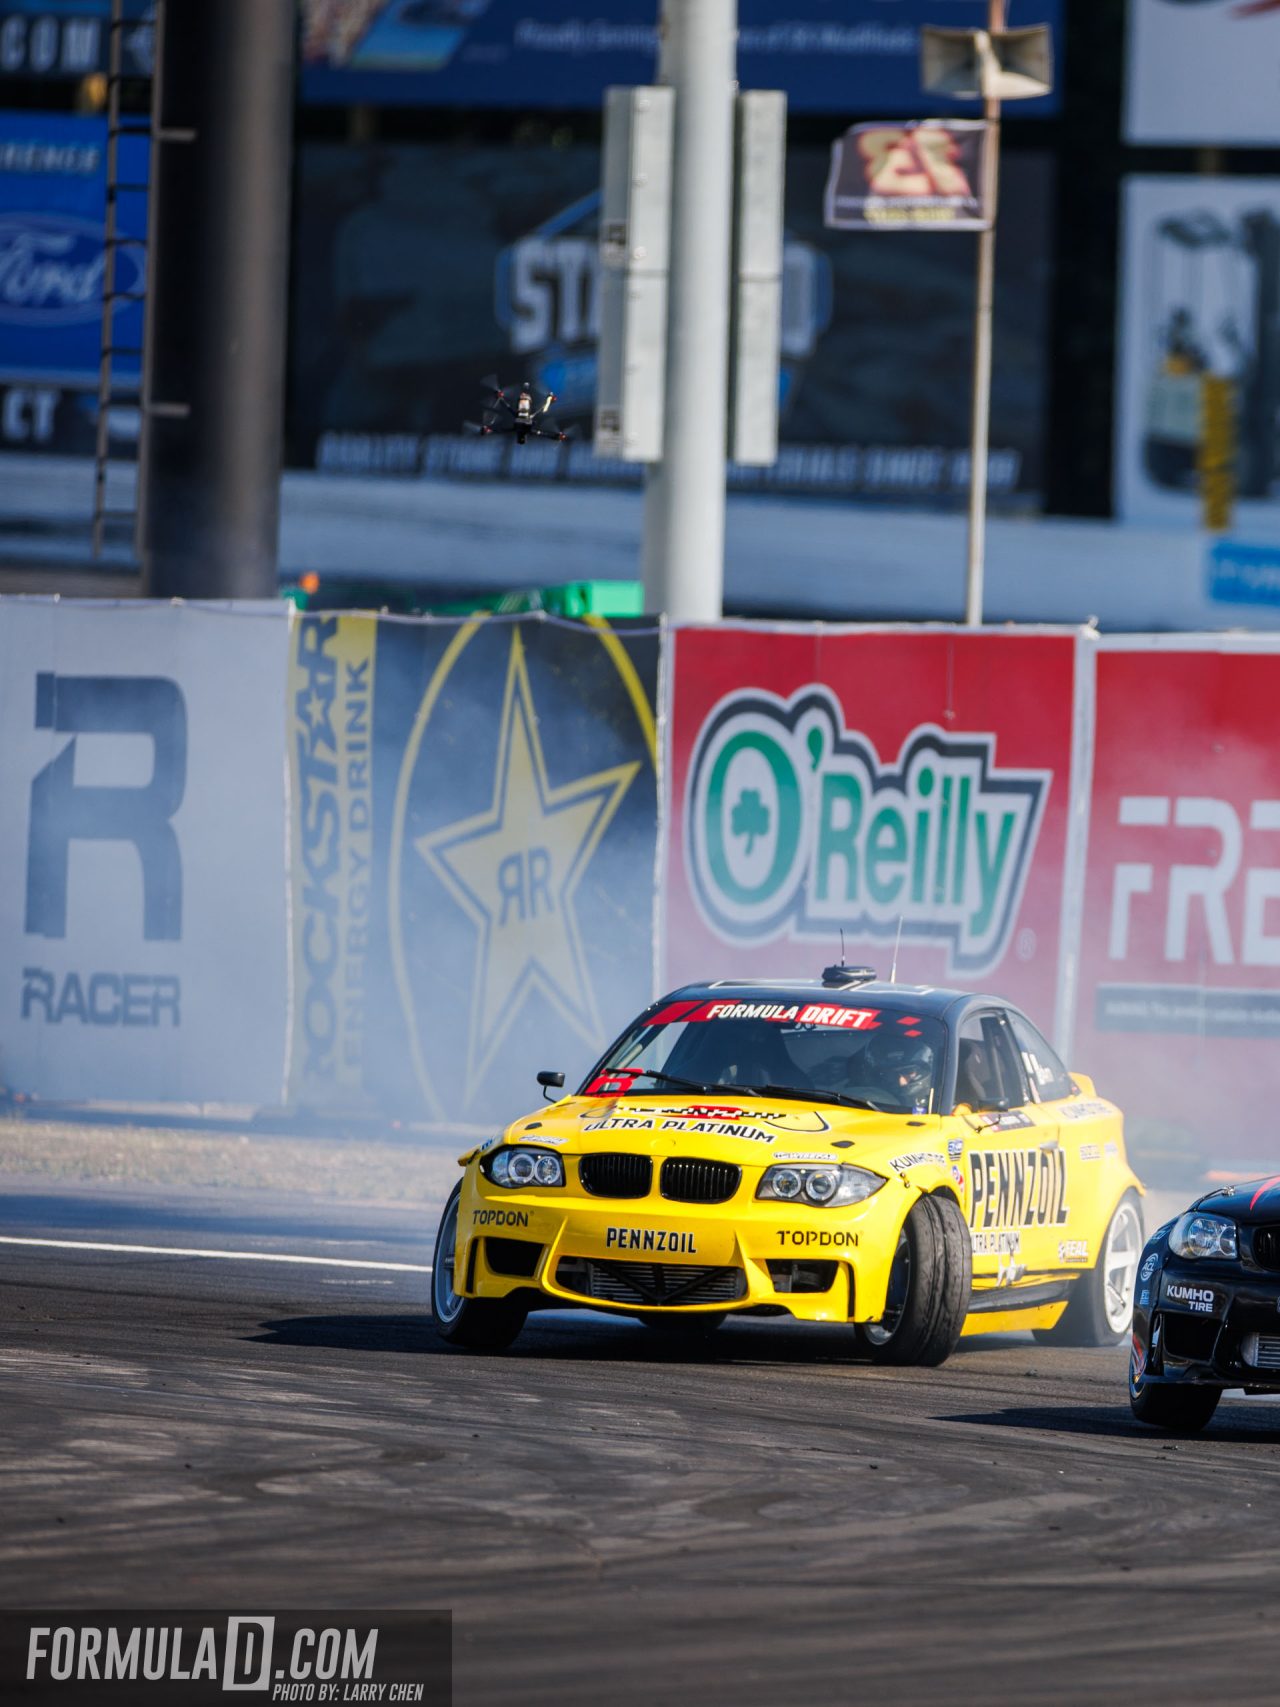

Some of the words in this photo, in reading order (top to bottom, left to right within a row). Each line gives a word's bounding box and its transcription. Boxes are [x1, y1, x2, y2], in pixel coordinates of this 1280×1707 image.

[346, 657, 373, 842] DRINK
[705, 726, 1018, 939] O'Reilly
[20, 967, 181, 1028] RACER
[707, 1003, 800, 1022] FORMULA
[801, 1006, 873, 1029] DRIFT
[583, 1118, 655, 1132] ULTRA
[662, 1118, 776, 1144] PLATINUM
[968, 1149, 1069, 1229] PENNZOIL
[473, 1210, 529, 1227] TOPDON
[606, 1227, 698, 1253] PENNZOIL
[776, 1230, 859, 1247] TOPDON
[1166, 1285, 1214, 1302] KUMHO
[1188, 1301, 1213, 1312] TIRE
